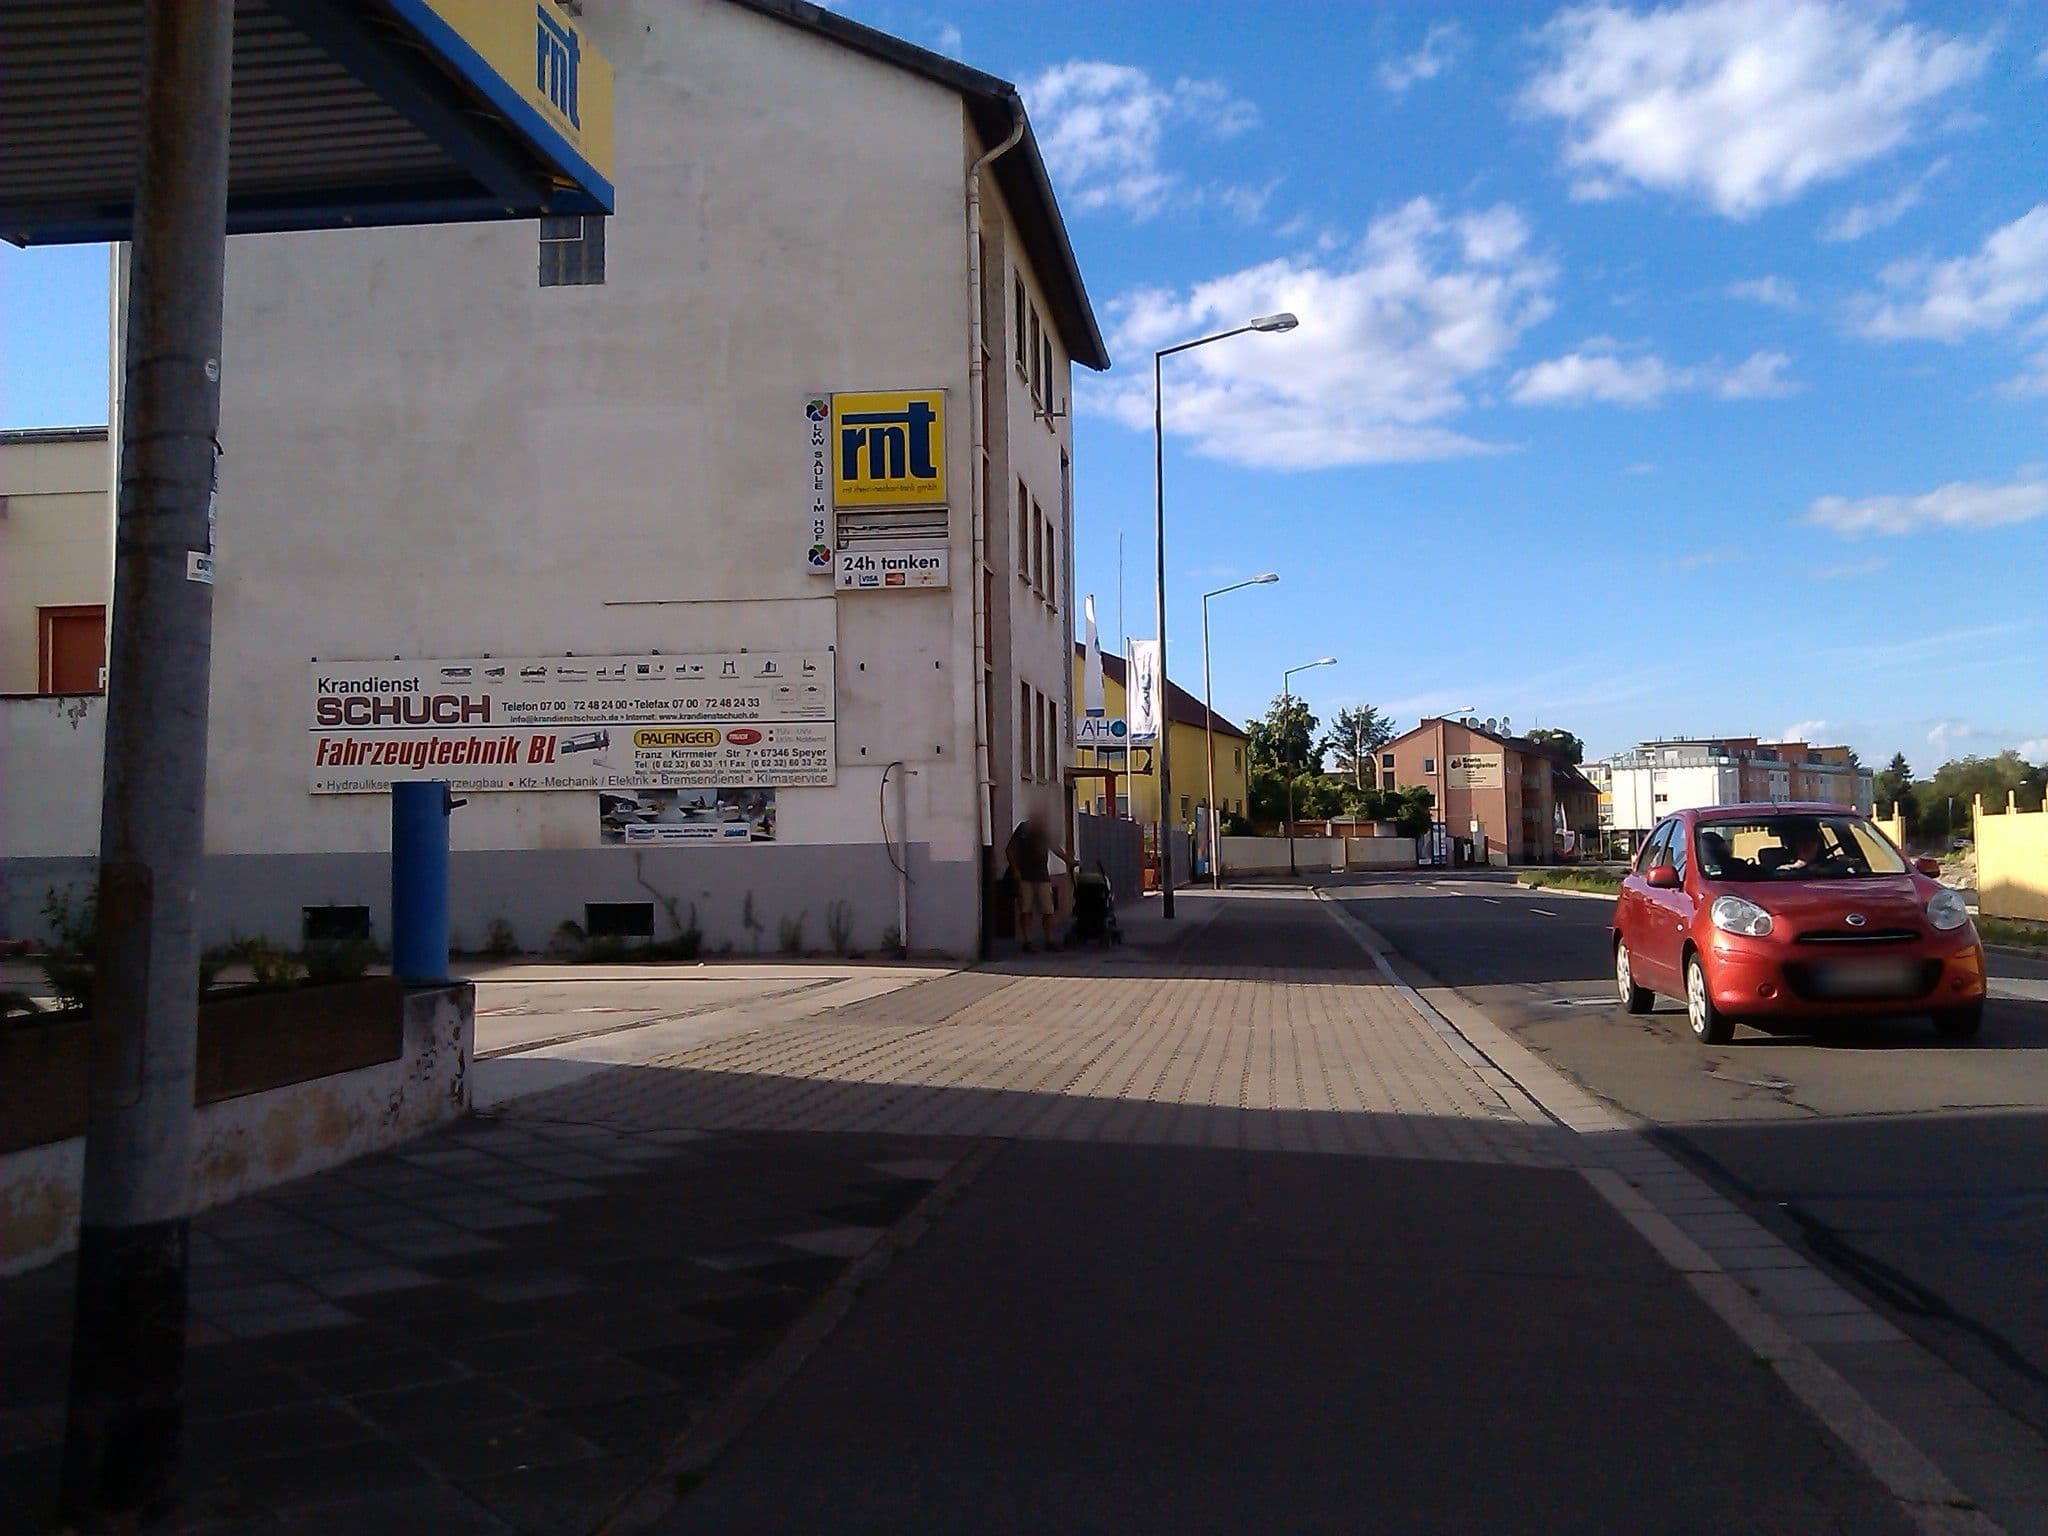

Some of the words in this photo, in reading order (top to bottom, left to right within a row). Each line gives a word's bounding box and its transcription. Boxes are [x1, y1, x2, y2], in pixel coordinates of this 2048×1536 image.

[537, 4, 580, 131] rnt
[811, 423, 825, 446] LKW
[841, 402, 937, 480] rnt
[813, 498, 825, 512] IM
[814, 519, 825, 542] HOF
[843, 555, 875, 571] 24h
[881, 554, 940, 570] tanken
[862, 575, 879, 583] VISA
[318, 677, 420, 694] Krandienst
[316, 695, 490, 725] SCHUCH
[502, 702, 538, 712] Telefon
[540, 702, 552, 711] 07
[554, 701, 566, 710] 00
[574, 701, 585, 710] 72
[588, 701, 600, 710] 48
[602, 701, 613, 710] 24
[615, 700, 627, 709] 00
[634, 699, 669, 710] Telefax
[673, 699, 684, 708] 07
[686, 699, 699, 708] 00
[706, 698, 717, 708] 72
[720, 698, 732, 708] 48
[734, 698, 746, 707] 24
[748, 698, 760, 707] 33
[640, 731, 715, 745] PALFINGER
[316, 735, 522, 770] Fahrzeugtechnik
[527, 735, 557, 764] BL
[635, 750, 662, 759] Franz
[671, 749, 717, 758] Kirrmeier
[745, 749, 752, 757] 7
[761, 748, 789, 757] 67346
[792, 748, 827, 760] Speyer
[730, 759, 746, 767] Fax
[327, 779, 391, 792] Hydraulikse
[519, 777, 537, 788] Kfz
[661, 772, 744, 786] Bremsendienst
[756, 772, 828, 784] Klimaservice
